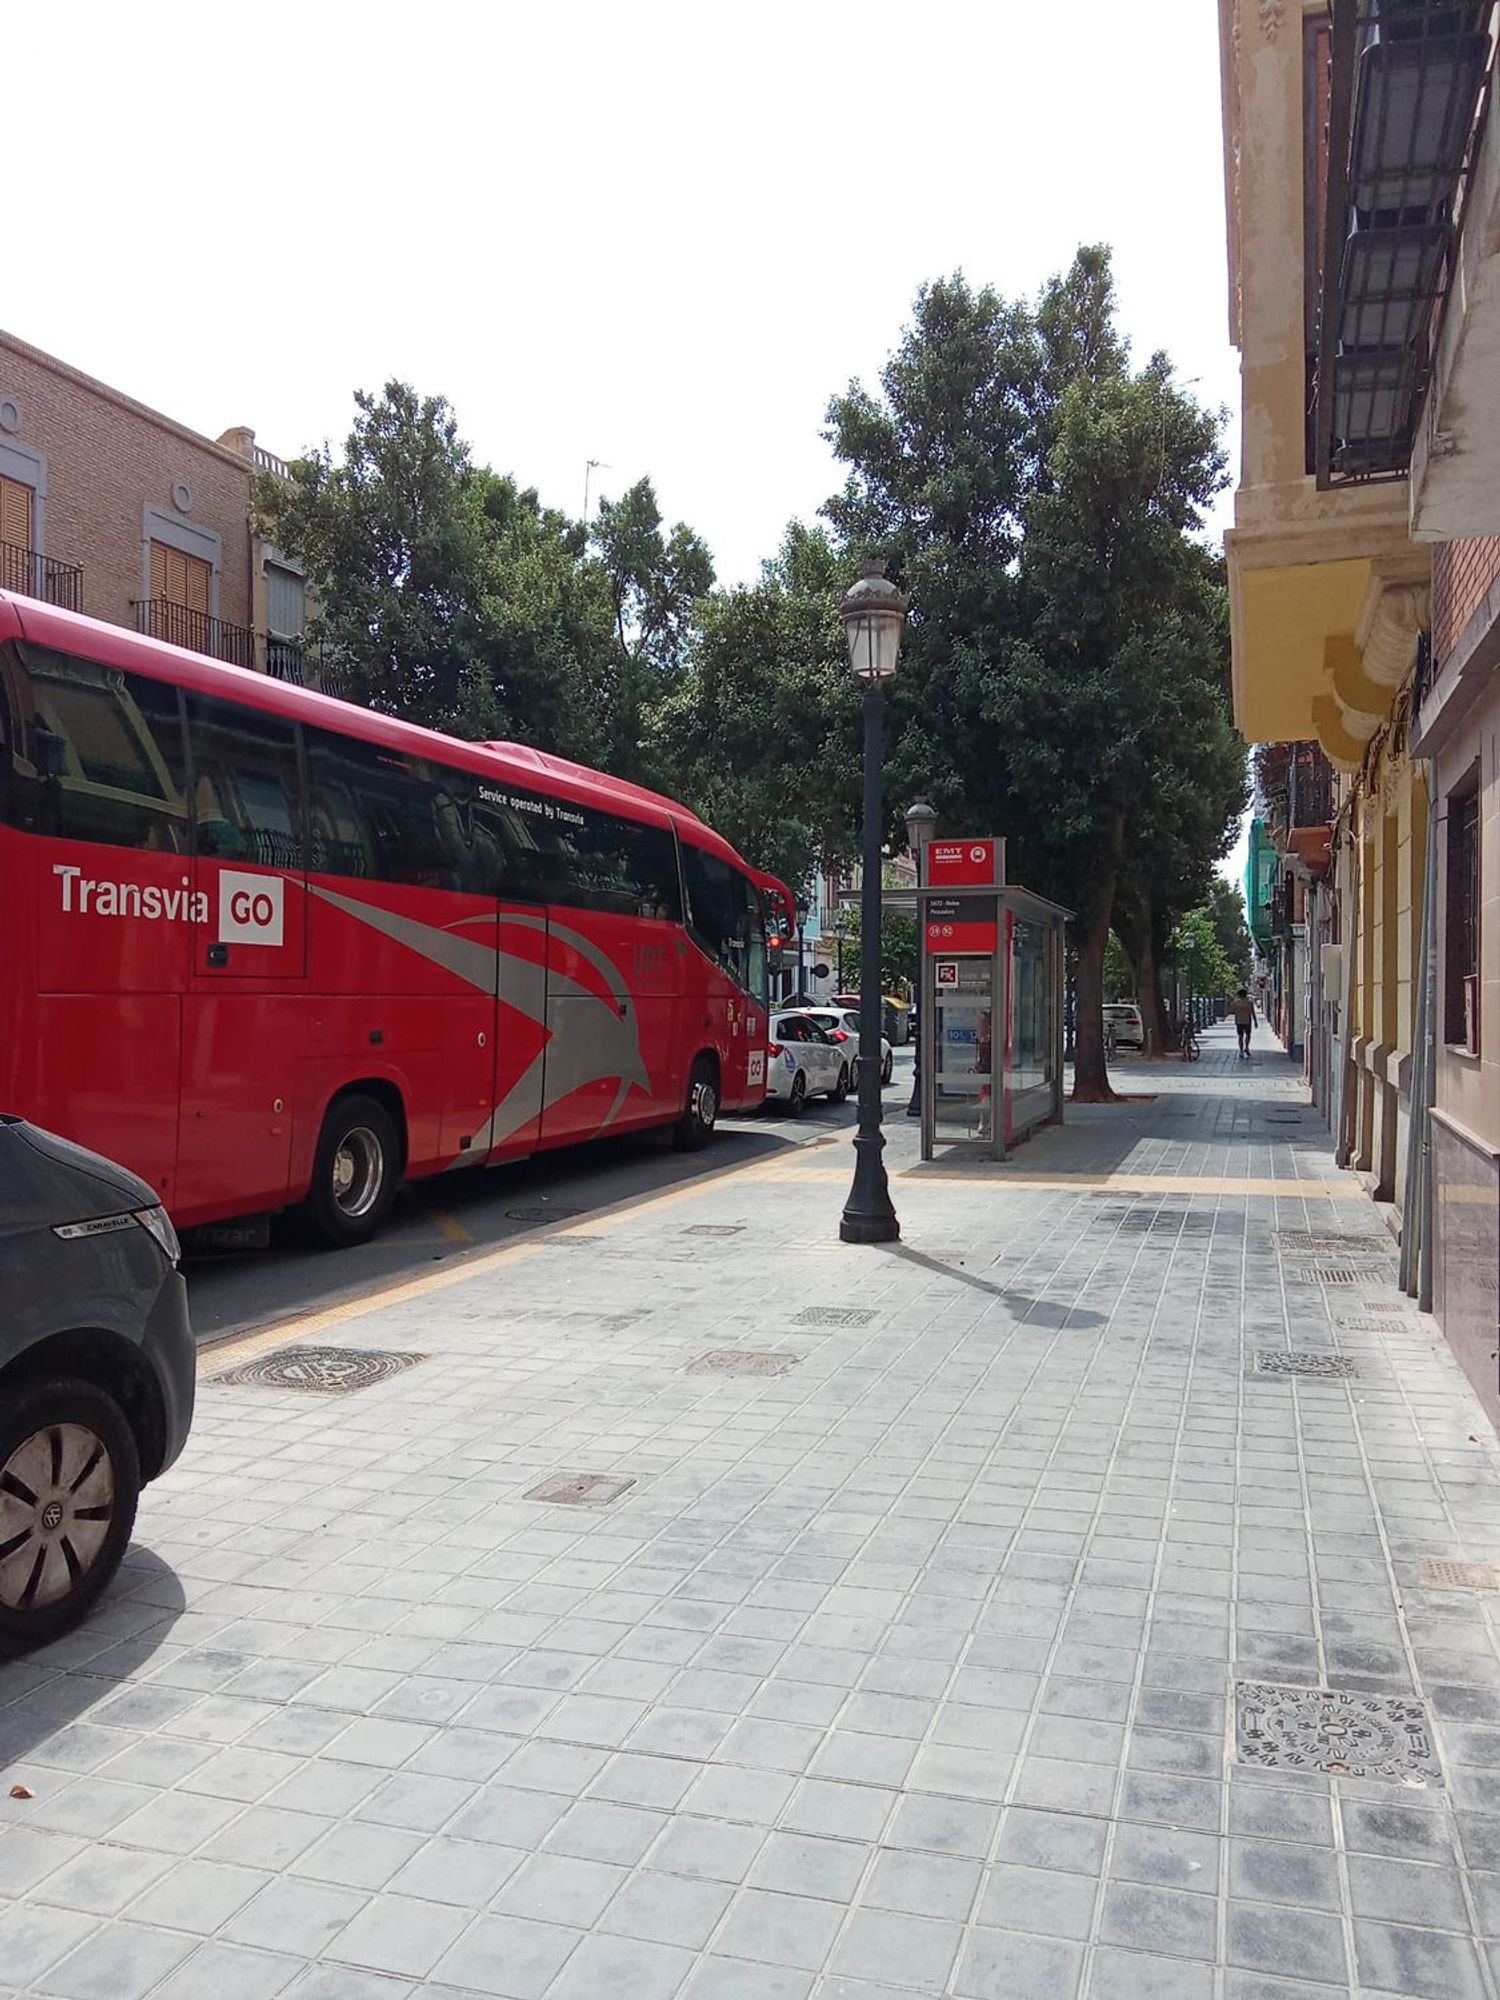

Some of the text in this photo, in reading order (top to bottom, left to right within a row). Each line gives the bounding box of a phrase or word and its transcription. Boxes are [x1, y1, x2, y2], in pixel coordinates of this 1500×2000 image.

[479, 786, 507, 805] Service
[511, 798, 542, 814] operated
[545, 804, 554, 819] by
[53, 864, 273, 926] Transvia GO
